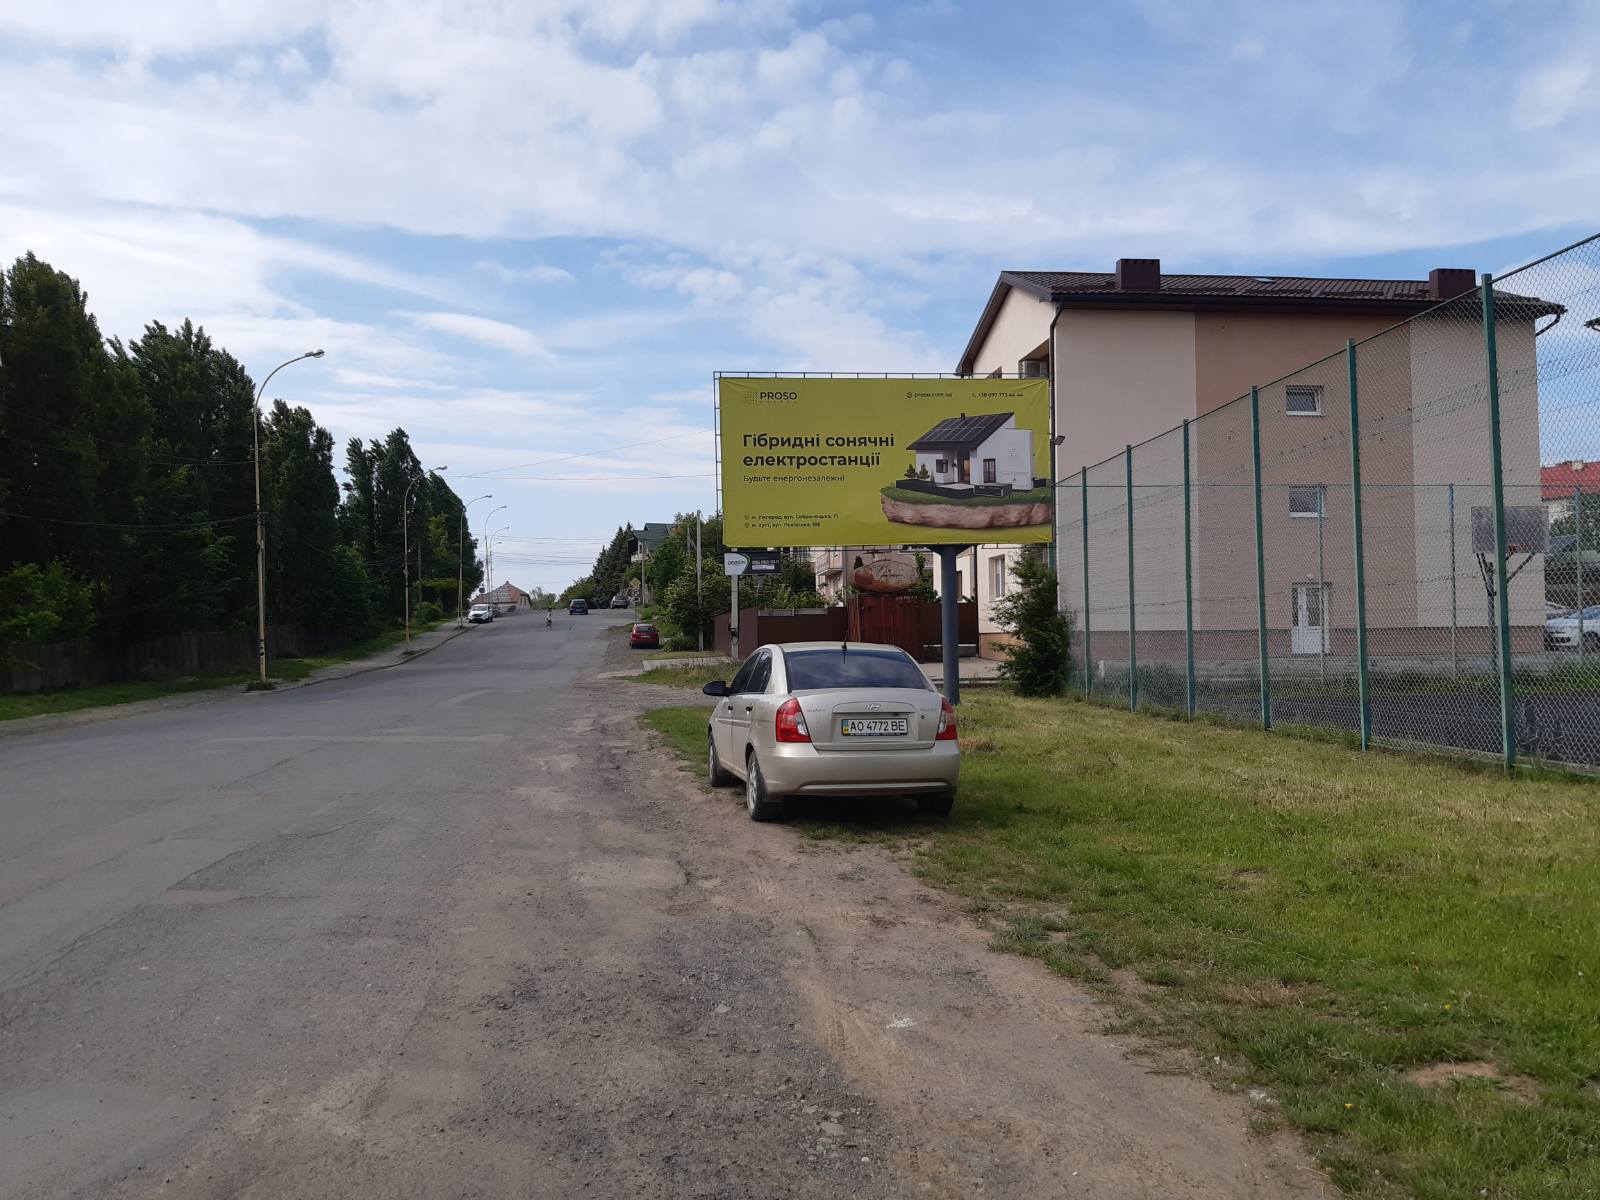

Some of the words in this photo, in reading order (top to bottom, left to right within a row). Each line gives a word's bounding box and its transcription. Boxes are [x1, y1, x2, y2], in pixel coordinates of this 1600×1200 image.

[760, 391, 797, 400] PROSO
[743, 433, 820, 450] Гібридні
[825, 433, 895, 447] сонячні
[743, 452, 881, 469] електростанції
[743, 475, 771, 483] Будьте
[773, 474, 845, 482] енергонезалежні
[850, 721, 864, 732] AO
[866, 721, 889, 732] 4772
[891, 720, 906, 732] BE
